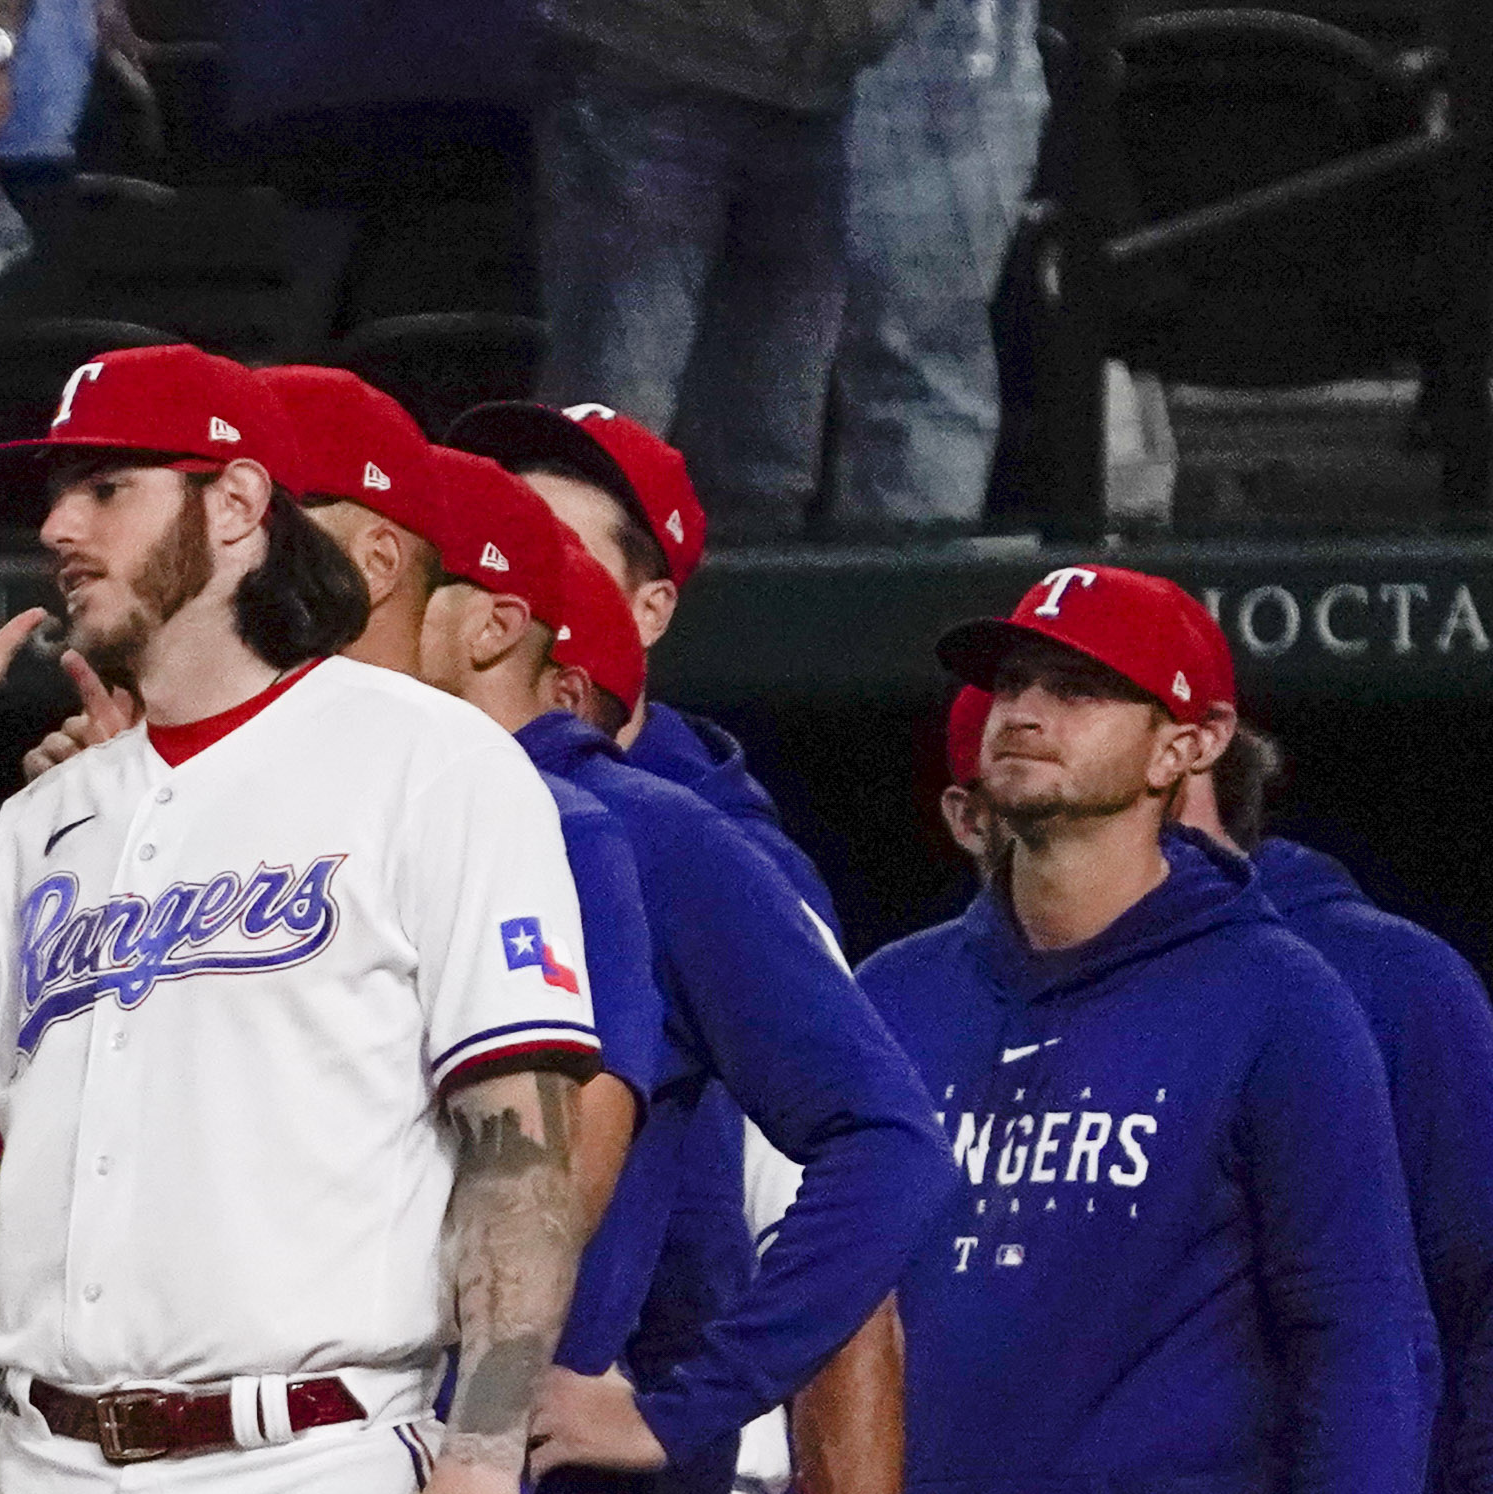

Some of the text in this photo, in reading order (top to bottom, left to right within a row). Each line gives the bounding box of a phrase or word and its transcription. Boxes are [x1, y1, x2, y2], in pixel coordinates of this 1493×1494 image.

[1035, 566, 1097, 617] T
[1205, 583, 1493, 656] OCTA
[16, 853, 351, 1014] Rangers
[936, 1111, 1158, 1187] NGERS
